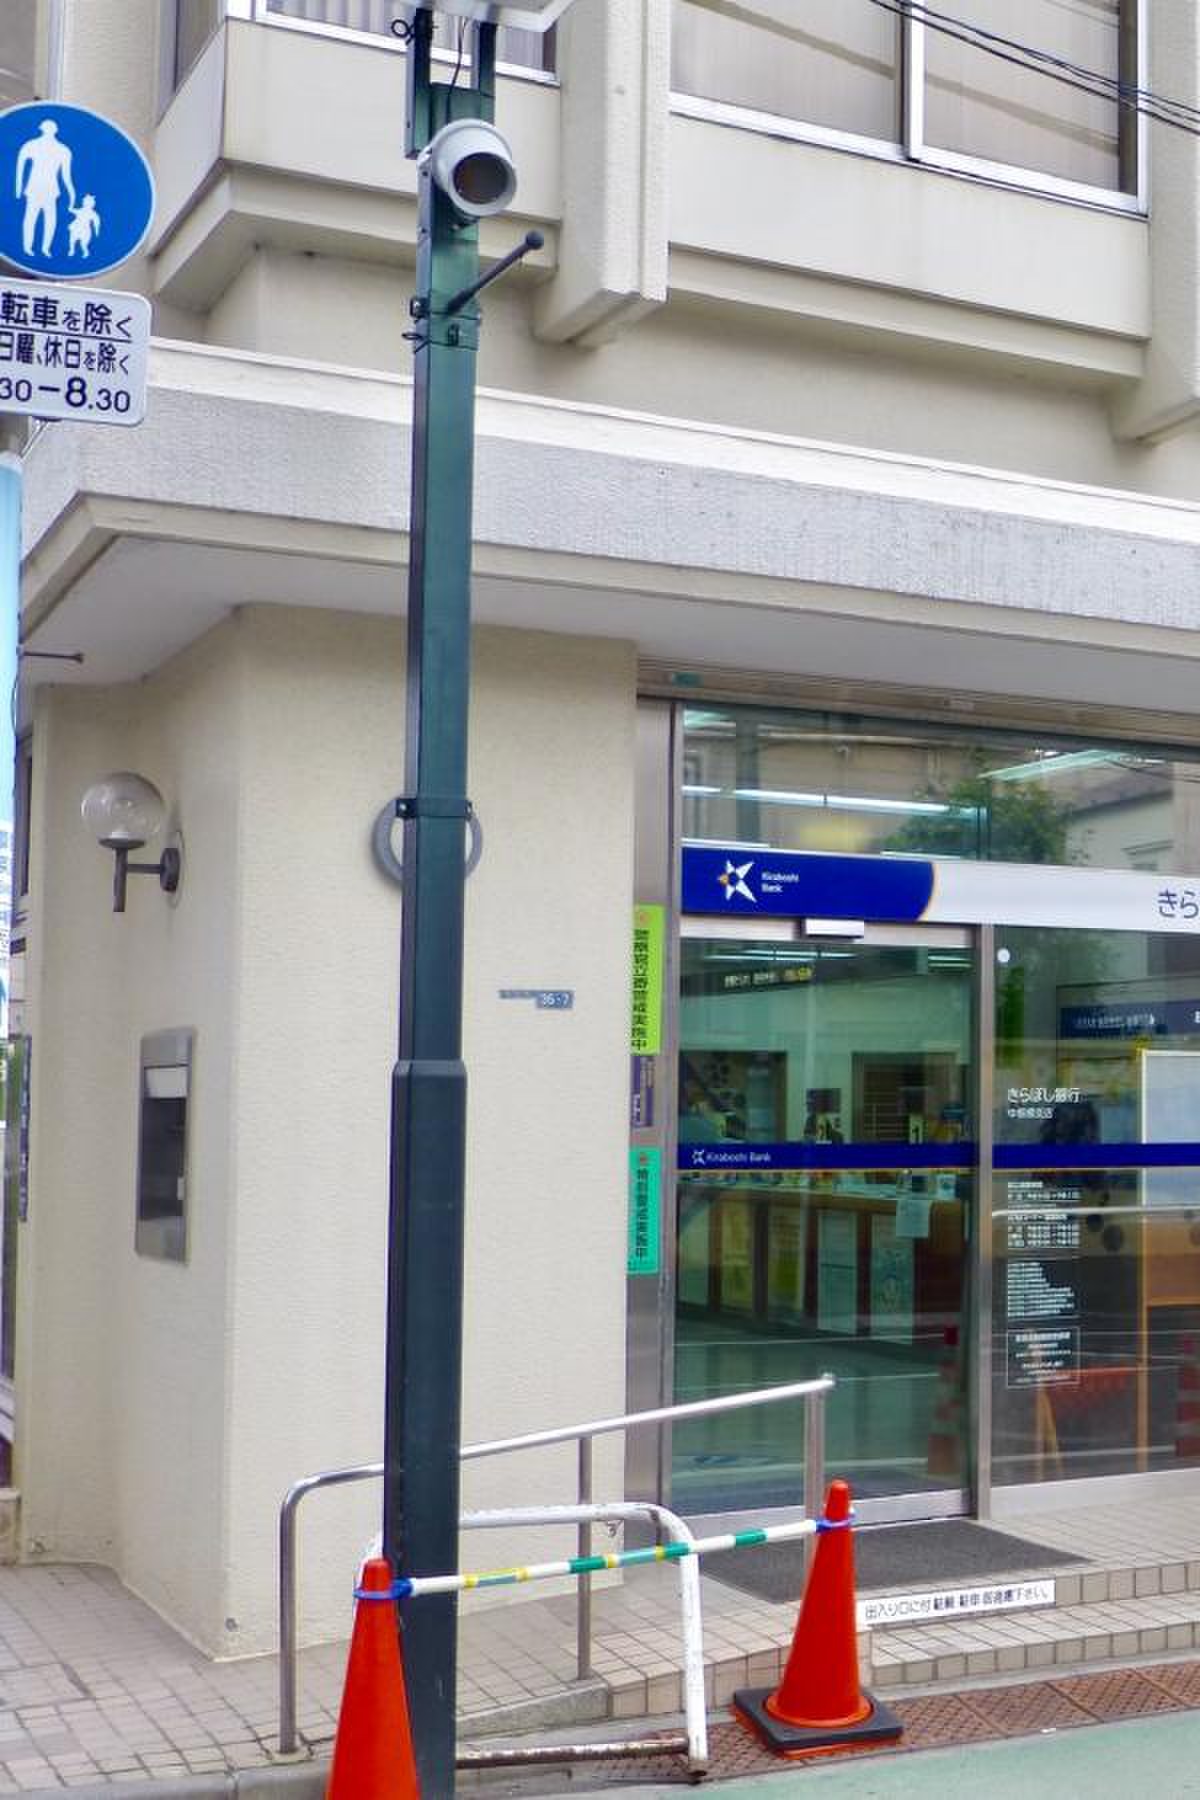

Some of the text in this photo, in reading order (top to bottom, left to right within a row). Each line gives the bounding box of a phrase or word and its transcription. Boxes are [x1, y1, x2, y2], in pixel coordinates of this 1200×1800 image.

[0, 291, 132, 338] 転車を除く
[761, 872, 800, 883] Kiraboshi
[761, 883, 784, 893] Bank
[1008, 1088, 1080, 1103] きらぼし銀行
[706, 1152, 771, 1162] Kiraboshi Bank
